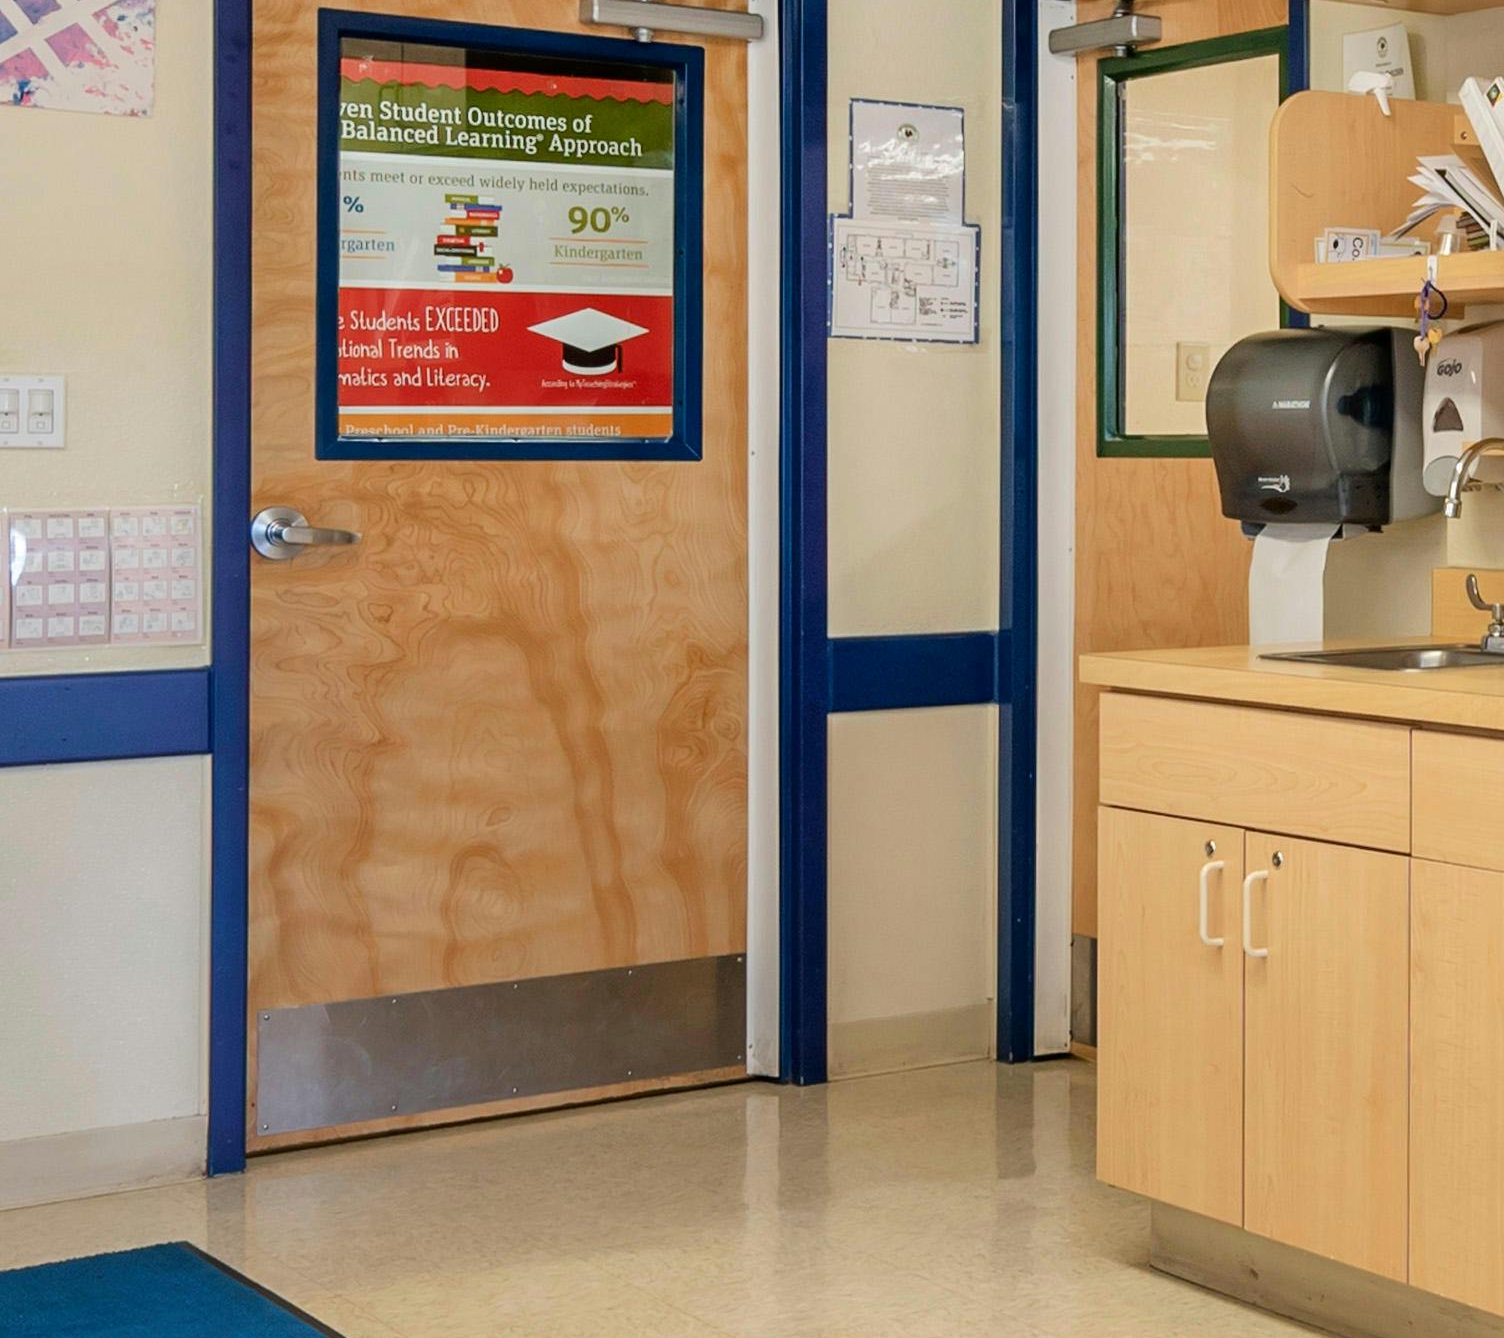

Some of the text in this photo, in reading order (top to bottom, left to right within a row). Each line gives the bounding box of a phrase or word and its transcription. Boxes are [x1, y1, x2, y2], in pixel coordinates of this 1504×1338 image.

[380, 100, 462, 125] Student
[467, 106, 567, 133] Outcomes
[573, 114, 593, 134] of
[341, 119, 439, 145] Balanced
[549, 134, 643, 158] Approach
[371, 170, 405, 184] meet
[410, 173, 424, 185] or
[427, 172, 475, 187] exceed
[479, 175, 525, 193] widely
[528, 177, 559, 192] held
[562, 179, 650, 198] expectations.
[568, 205, 630, 235] 90%
[553, 245, 644, 263] Kindergarten
[350, 309, 421, 333] Students
[425, 306, 500, 334] EXCEEDED
[388, 338, 441, 360] Trends
[445, 341, 460, 360] in
[392, 367, 423, 388] and
[425, 367, 492, 393] Literacy.
[345, 423, 415, 436] Preschool
[417, 423, 445, 436] and
[565, 423, 622, 436] students
